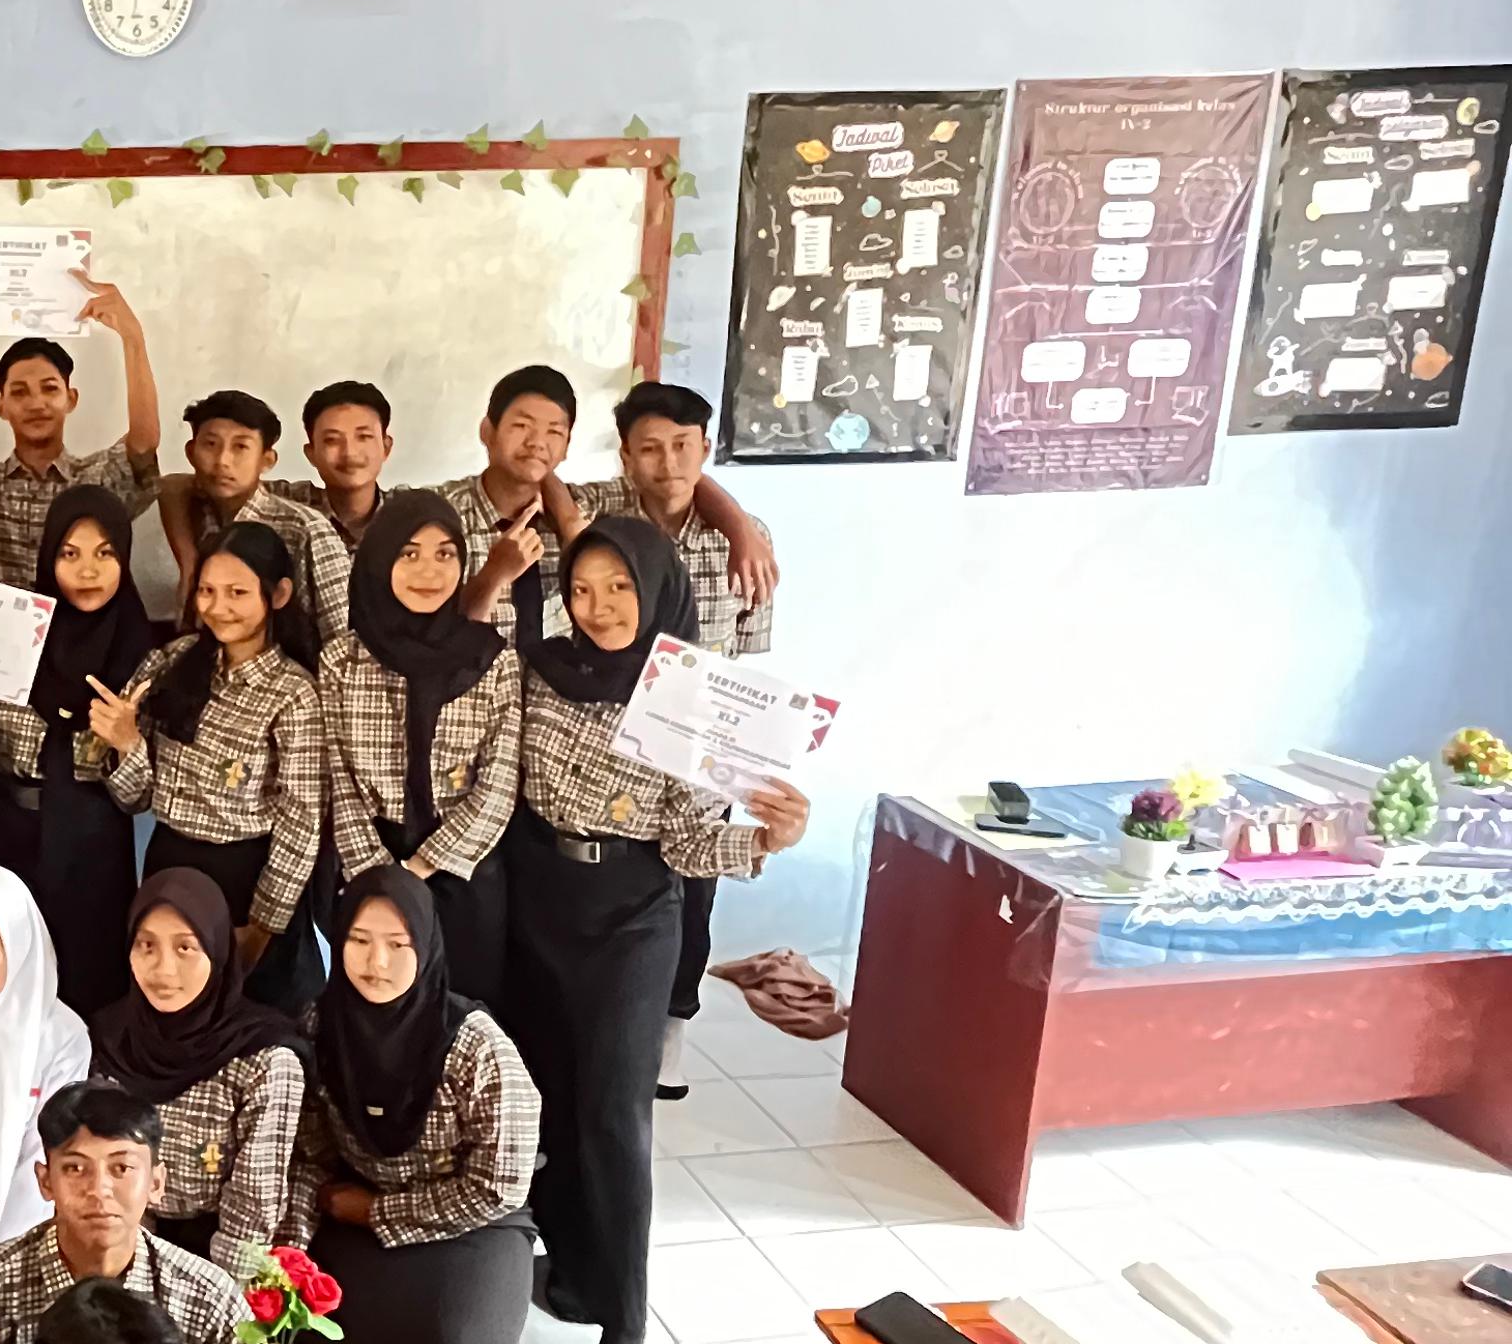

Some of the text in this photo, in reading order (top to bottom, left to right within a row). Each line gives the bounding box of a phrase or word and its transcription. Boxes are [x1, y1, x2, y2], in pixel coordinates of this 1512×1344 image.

[104, 0, 113, 12] 8
[116, 15, 125, 28] 7
[149, 15, 159, 29] 5
[132, 23, 142, 37] 6
[836, 126, 899, 148] Jadwal
[871, 154, 909, 173] Piket
[707, 672, 778, 705] SERTIFIKAT
